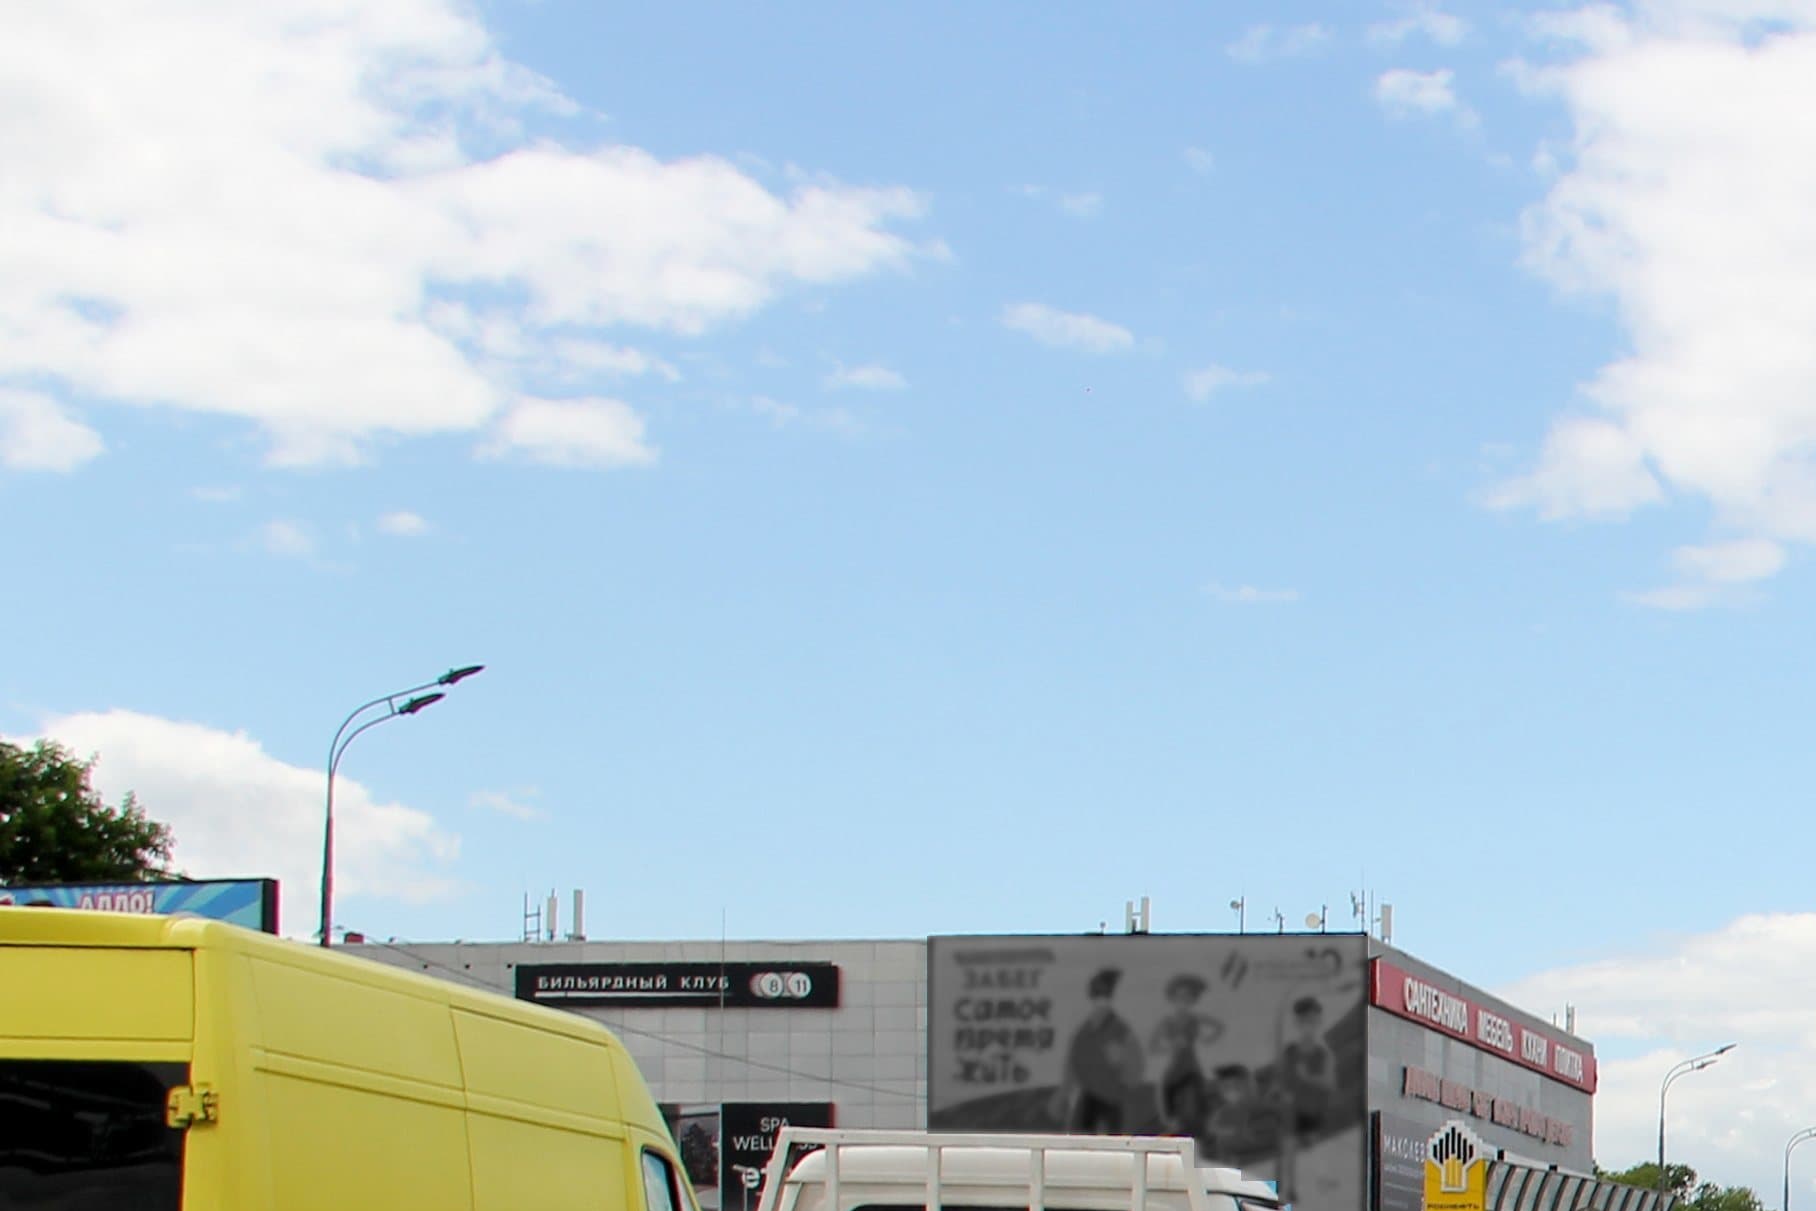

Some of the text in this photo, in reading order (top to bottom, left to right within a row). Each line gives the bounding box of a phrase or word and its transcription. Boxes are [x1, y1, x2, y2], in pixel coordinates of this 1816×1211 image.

[536, 974, 730, 990] БИЛЬЯРДНЫЙ КЛУБ
[1403, 976, 1469, 1034] САНТЕХНИКА
[1477, 1009, 1514, 1053] МЕБЕЛЬ
[760, 1117, 790, 1133] SPA
